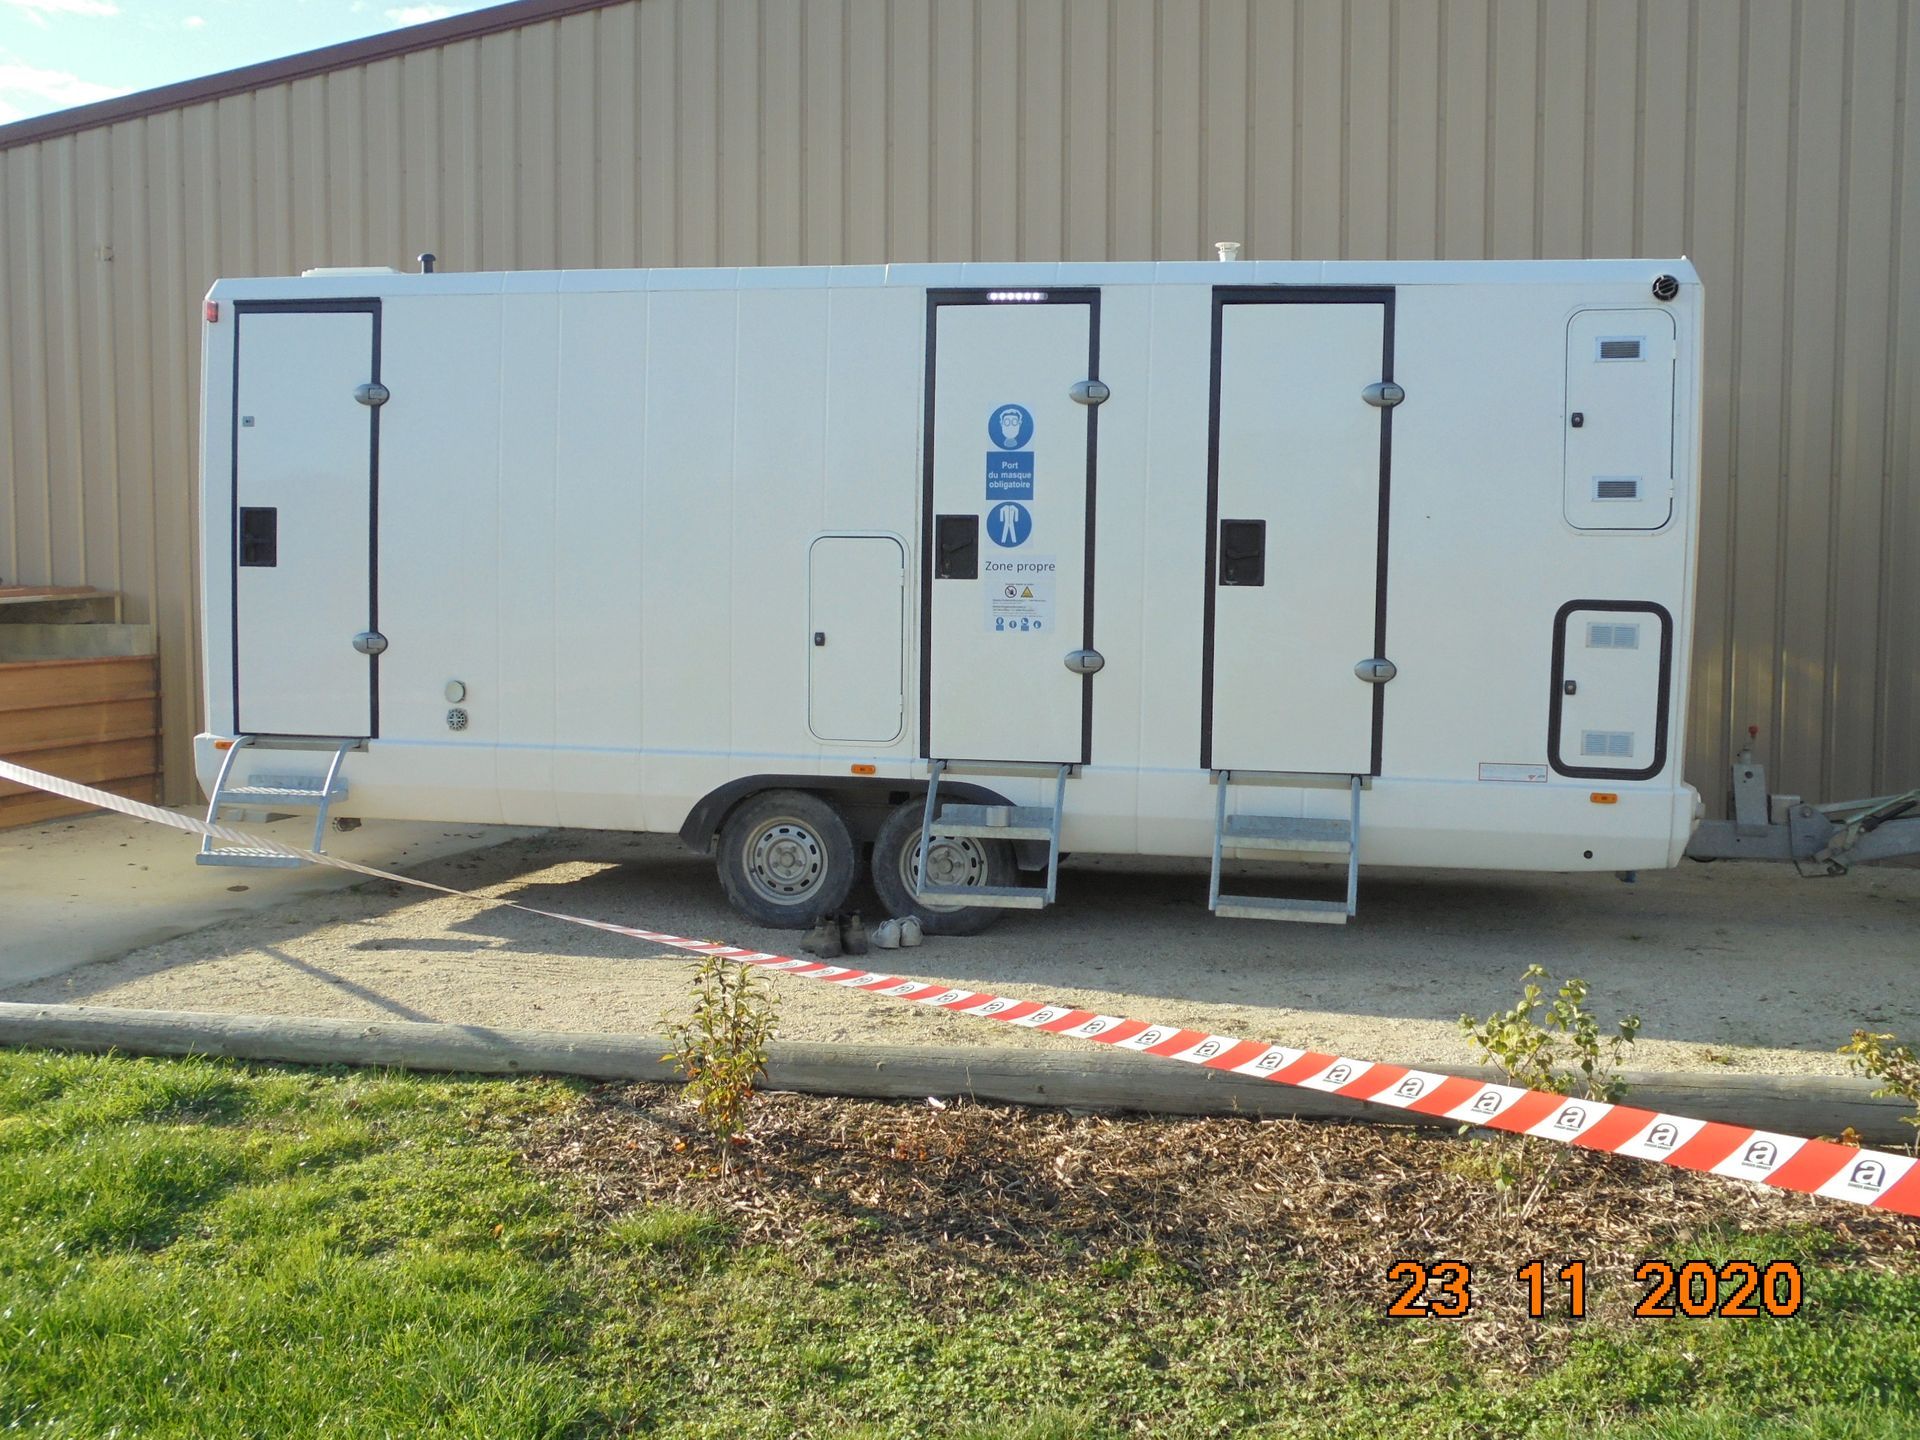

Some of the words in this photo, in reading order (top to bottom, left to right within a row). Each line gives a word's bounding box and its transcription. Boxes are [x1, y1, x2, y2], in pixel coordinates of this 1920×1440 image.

[1001, 461, 1019, 470] Port
[1000, 472, 1032, 481] masque
[988, 480, 1031, 490] obligatoire
[984, 560, 1014, 571] Zone
[1016, 563, 1056, 574] propre
